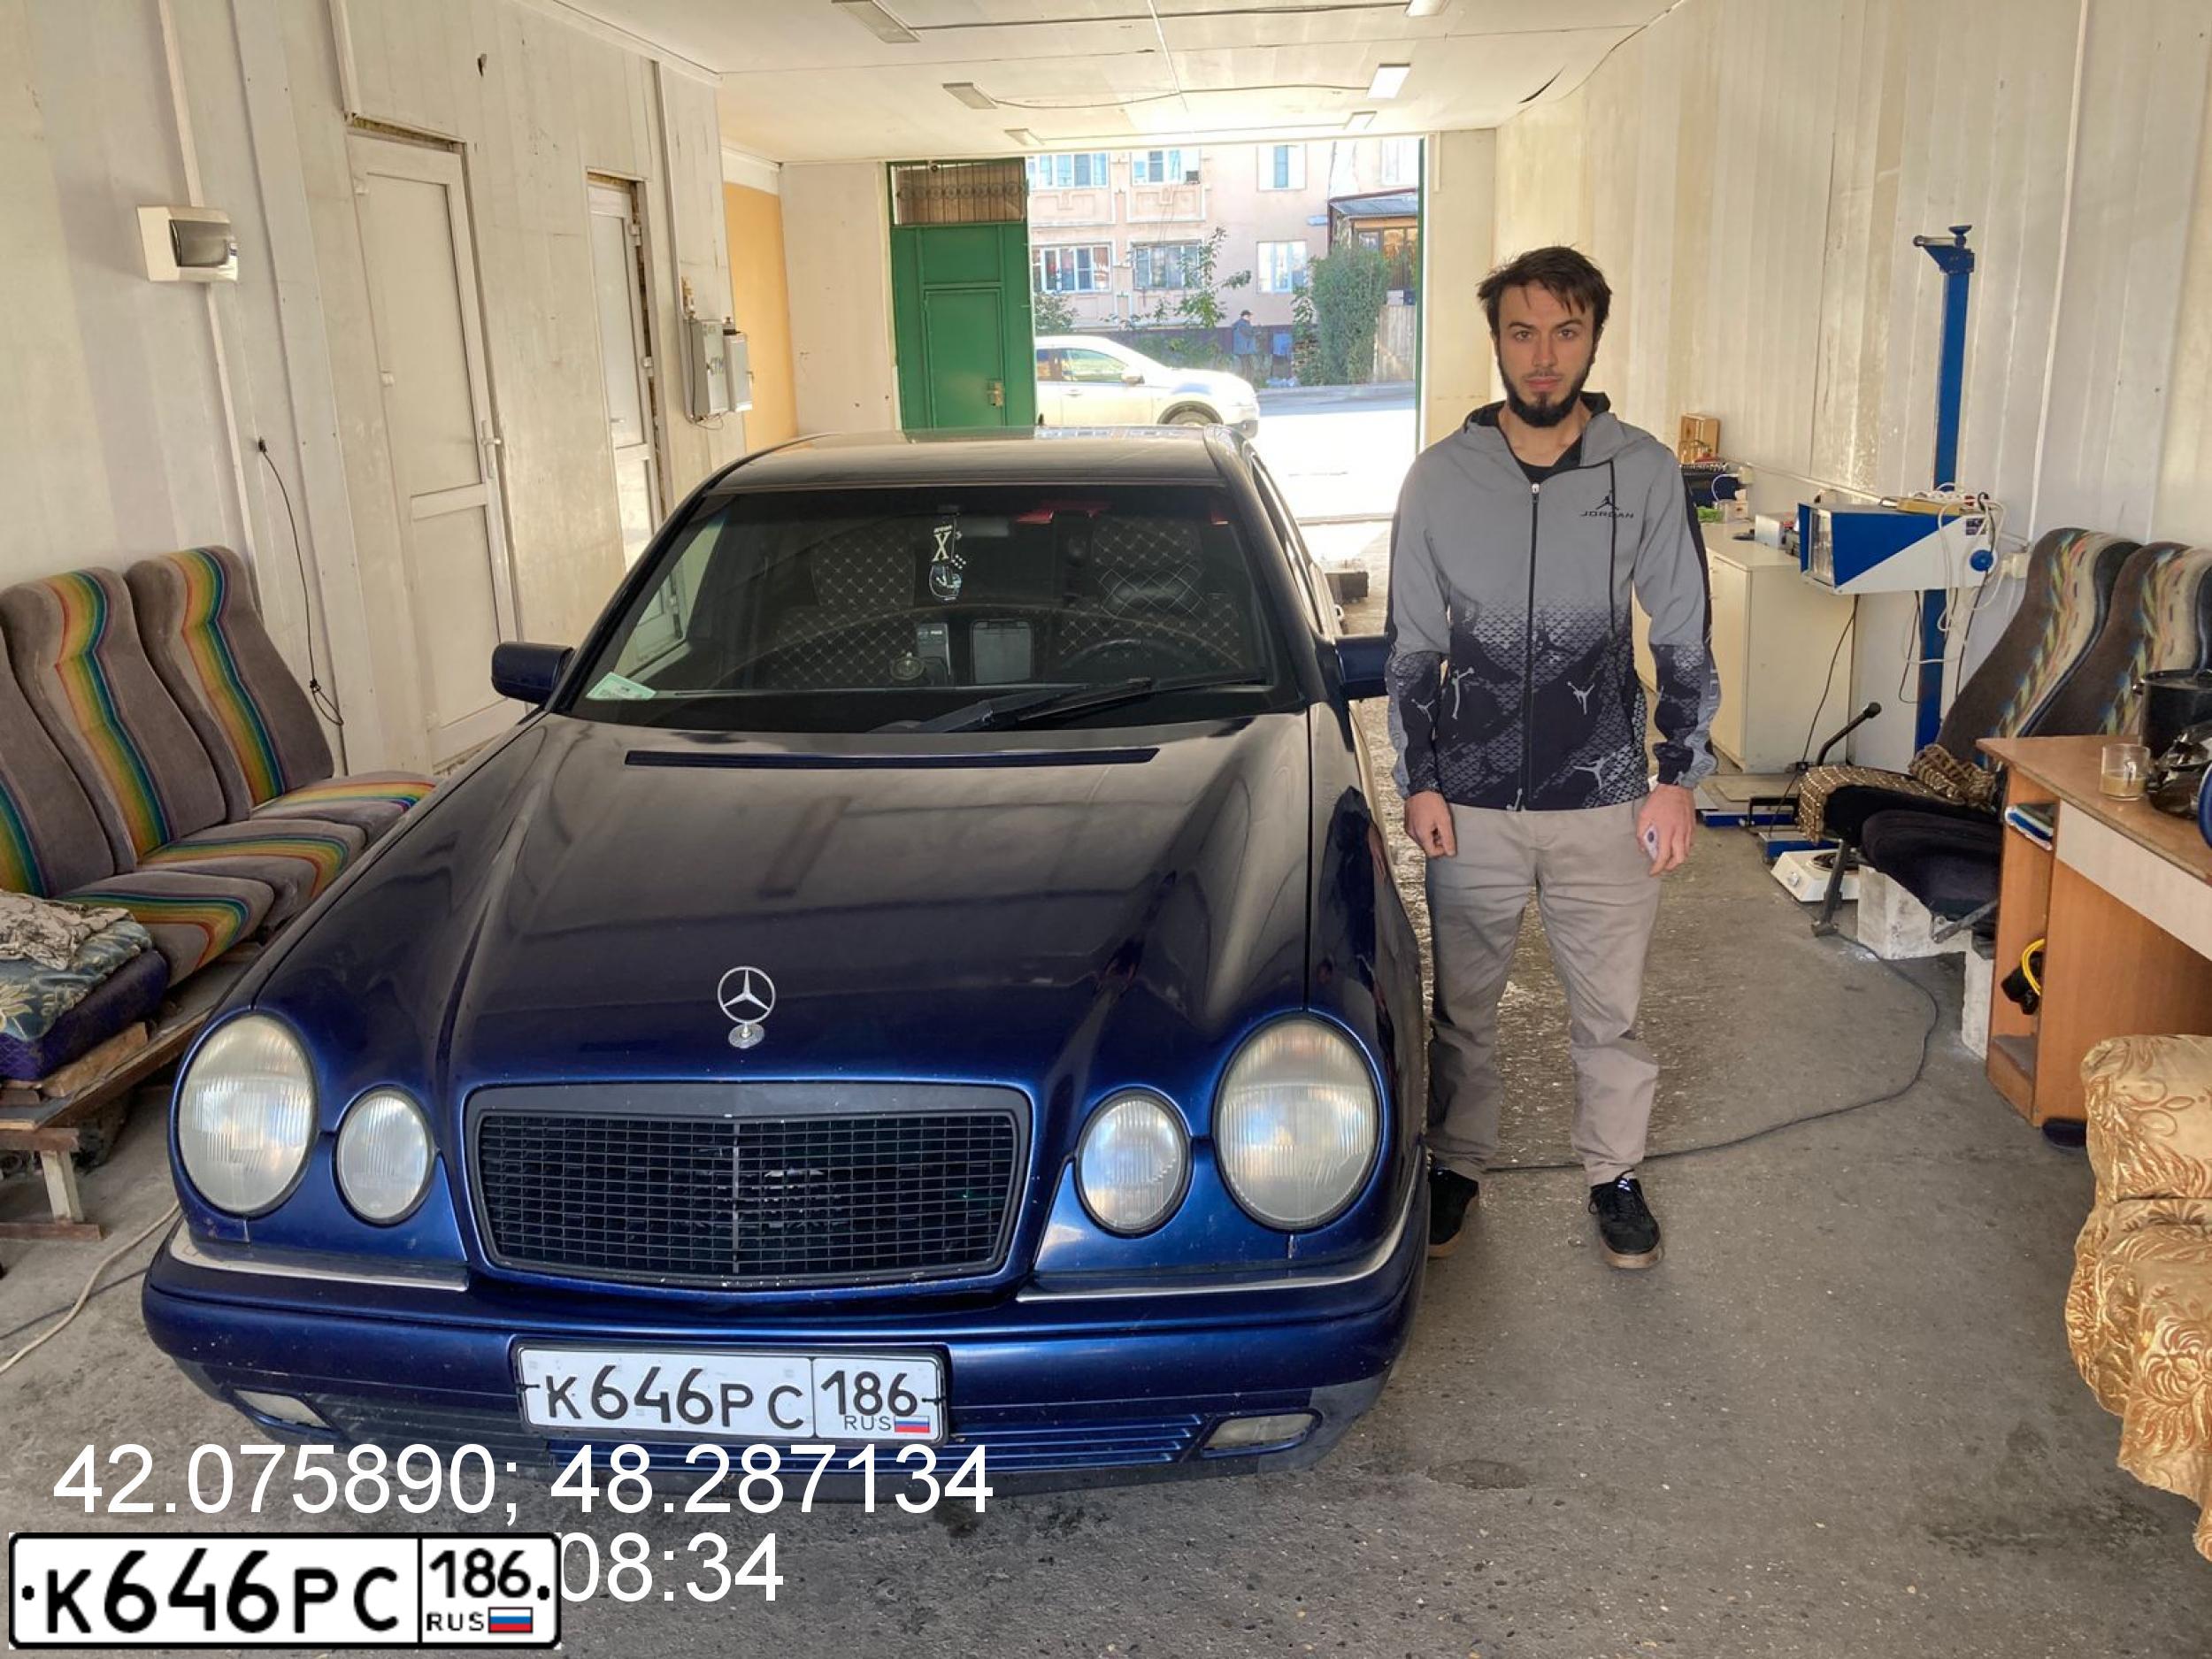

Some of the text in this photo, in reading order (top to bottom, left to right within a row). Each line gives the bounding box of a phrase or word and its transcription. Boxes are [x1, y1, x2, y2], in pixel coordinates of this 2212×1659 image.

[545, 1364, 918, 1431] К646РС 186
[843, 1415, 892, 1432] RUS
